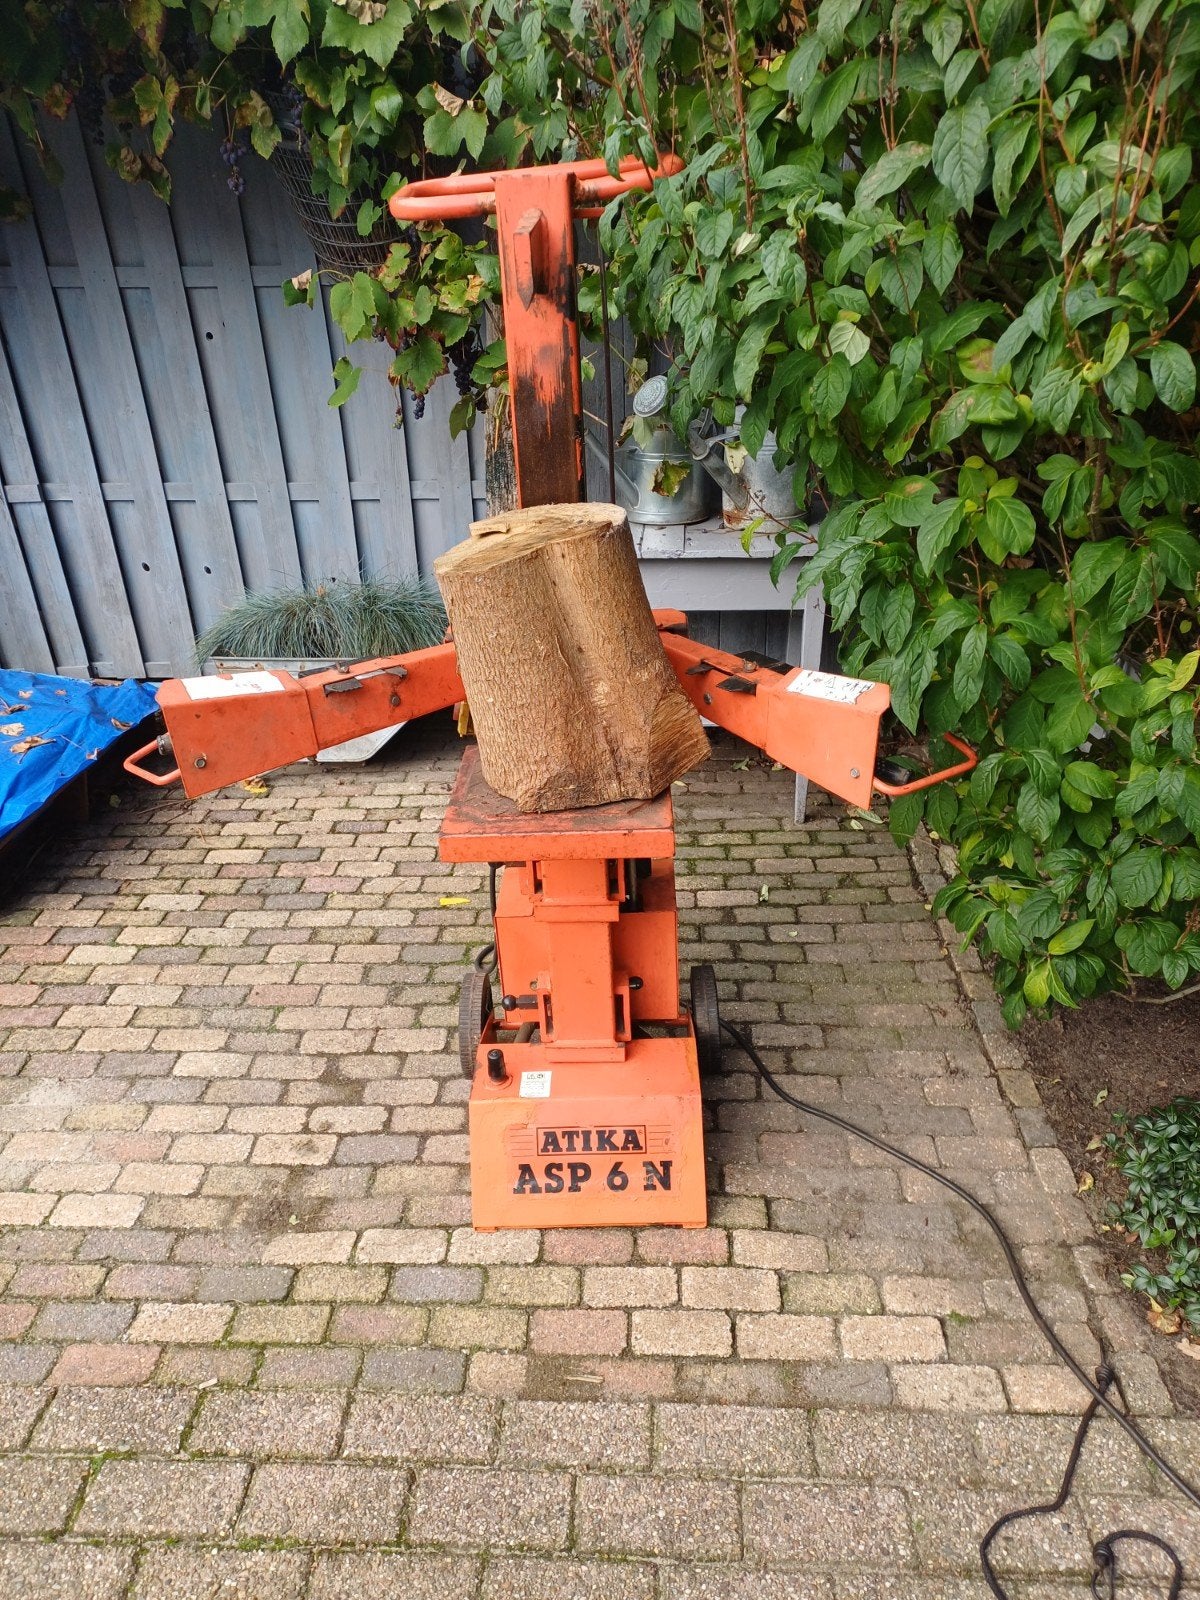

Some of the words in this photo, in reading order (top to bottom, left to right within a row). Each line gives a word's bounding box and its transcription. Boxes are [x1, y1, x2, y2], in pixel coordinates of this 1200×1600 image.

[540, 1129, 643, 1153] ATIKA
[513, 1162, 592, 1194] ASP
[606, 1161, 629, 1192] 6
[643, 1160, 673, 1191] N
